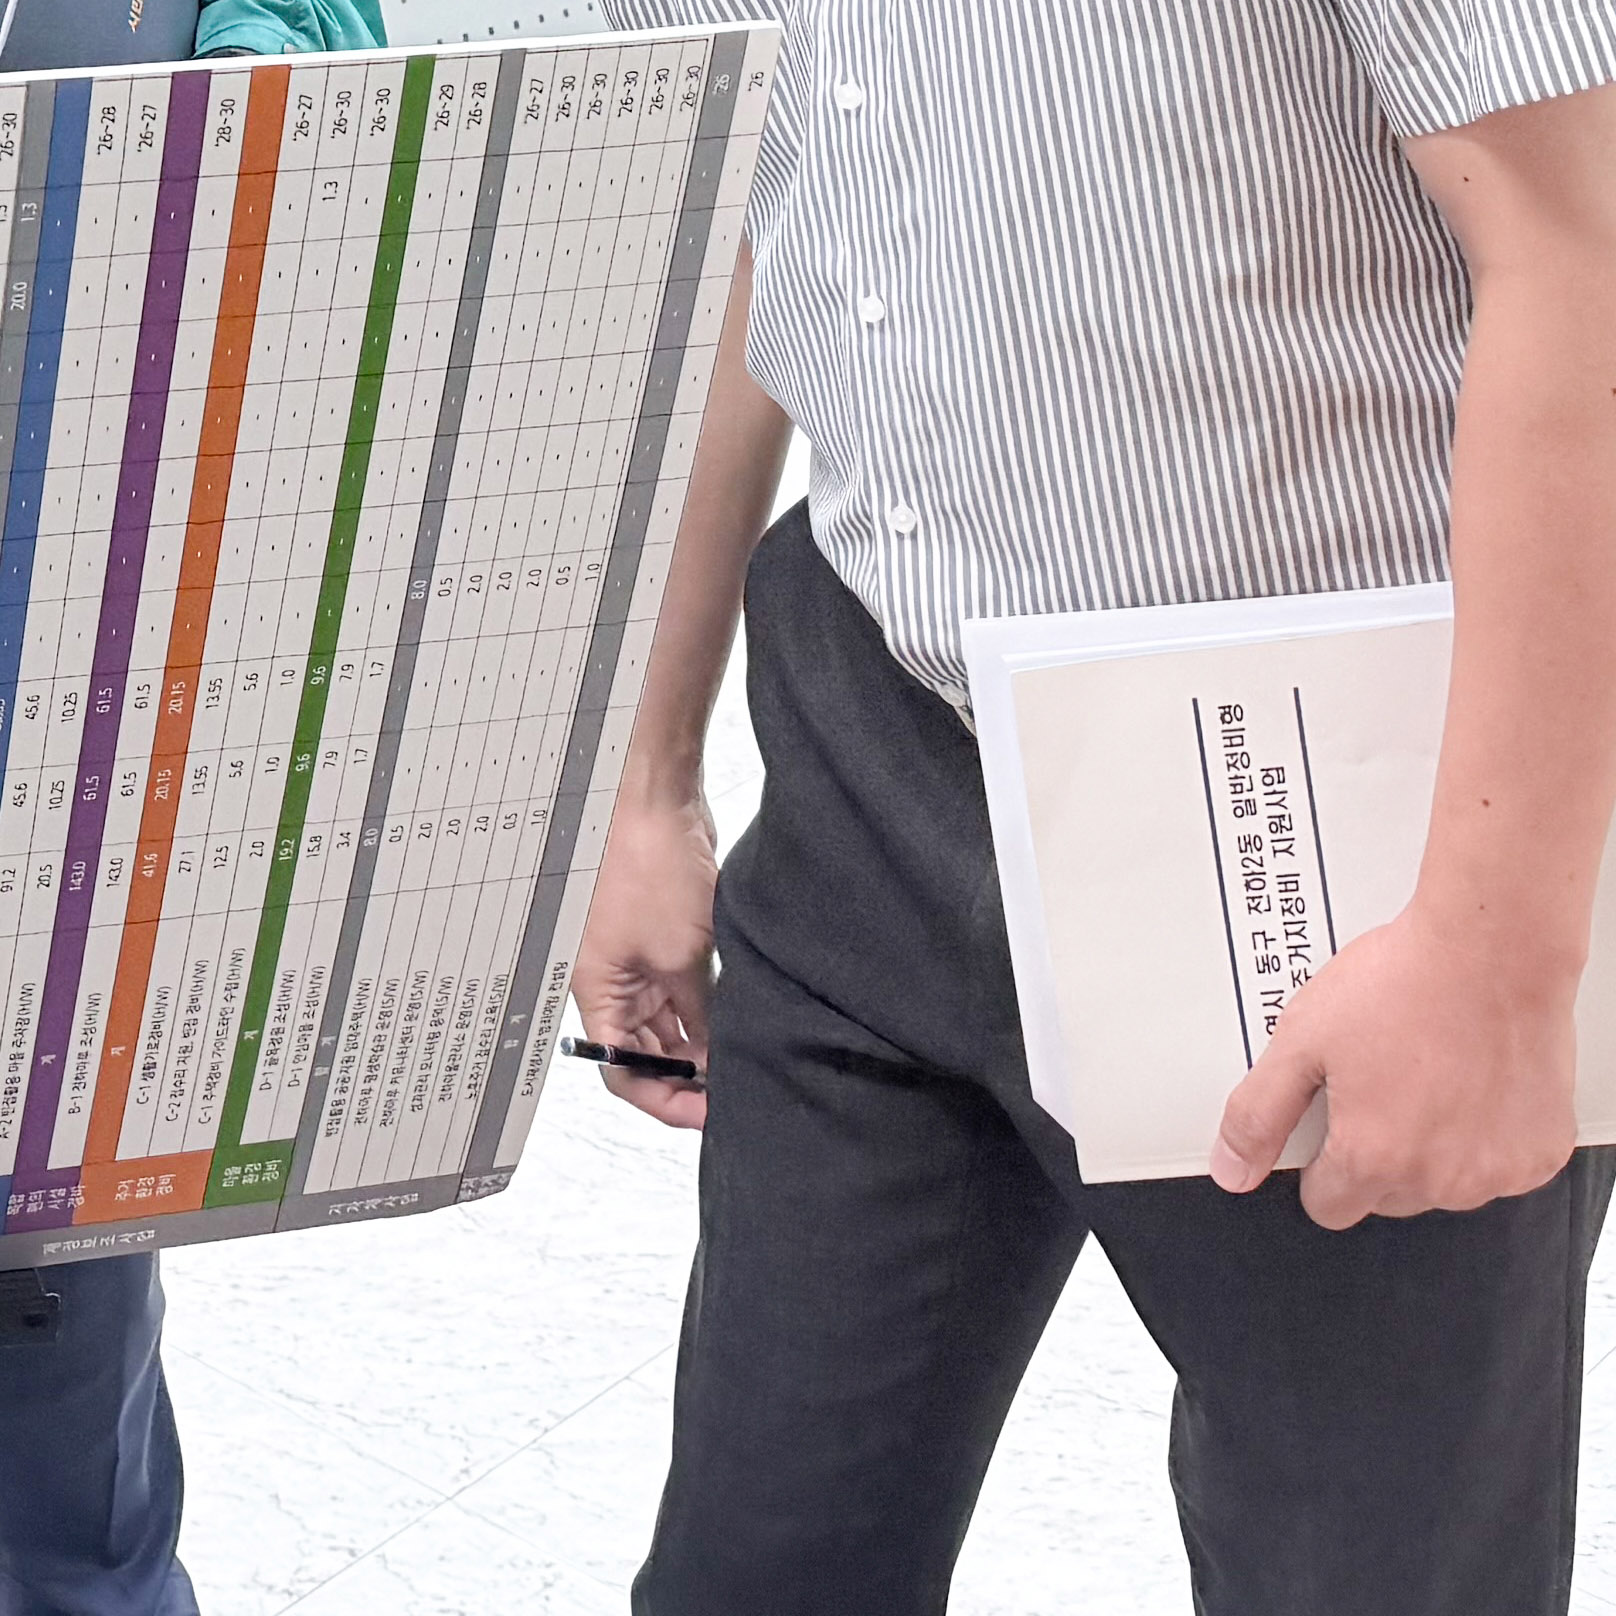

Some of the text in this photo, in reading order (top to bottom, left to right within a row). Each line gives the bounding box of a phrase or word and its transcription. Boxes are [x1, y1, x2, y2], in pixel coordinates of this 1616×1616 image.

[11, 281, 28, 310] 20.0
[410, 579, 427, 600] 8.0
[295, 753, 312, 772] 9.6
[1217, 702, 1257, 819] 일반정비형
[84, 775, 100, 800] 61.5
[155, 768, 171, 800] 20.15
[191, 765, 209, 795] 13.55
[12, 782, 28, 807] 45.6
[48, 780, 65, 810] 10.25
[1259, 766, 1297, 857] 지원사업
[213, 845, 229, 868] 12.5
[278, 839, 295, 861] 19.2
[306, 835, 323, 859] 15.8
[36, 864, 53, 888] 20.5
[69, 861, 86, 891] 143.0
[142, 853, 158, 877] 41.6
[1238, 832, 1273, 916] 전하2동
[0, 868, 16, 893] 91.2
[1251, 930, 1281, 974] 동구
[68, 1095, 82, 1114] B-1
